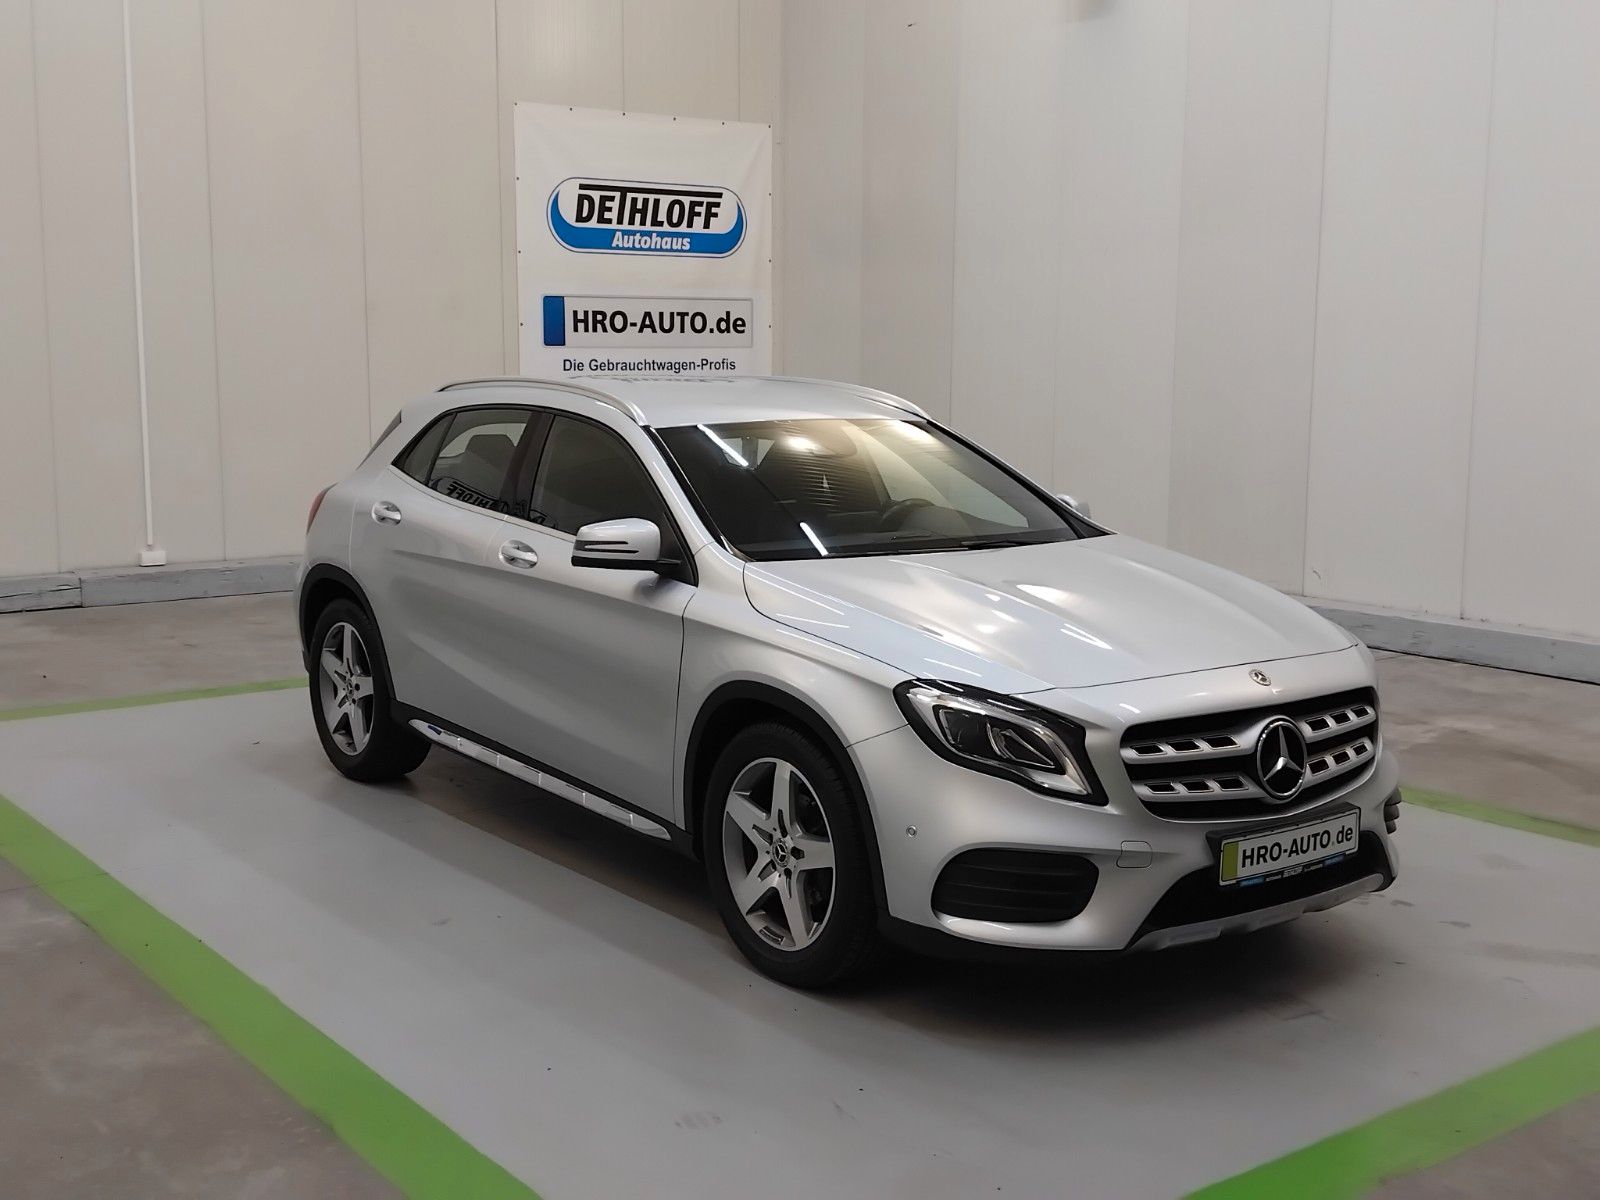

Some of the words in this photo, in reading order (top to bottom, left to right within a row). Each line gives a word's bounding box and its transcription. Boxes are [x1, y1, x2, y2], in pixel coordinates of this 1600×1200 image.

[575, 184, 722, 229] DETHLOFF
[612, 231, 690, 250] Autohaus
[573, 310, 746, 334] HRO-AUTO.de
[563, 359, 584, 372] Die
[589, 358, 736, 375] Gebrauchtwagen-Profis
